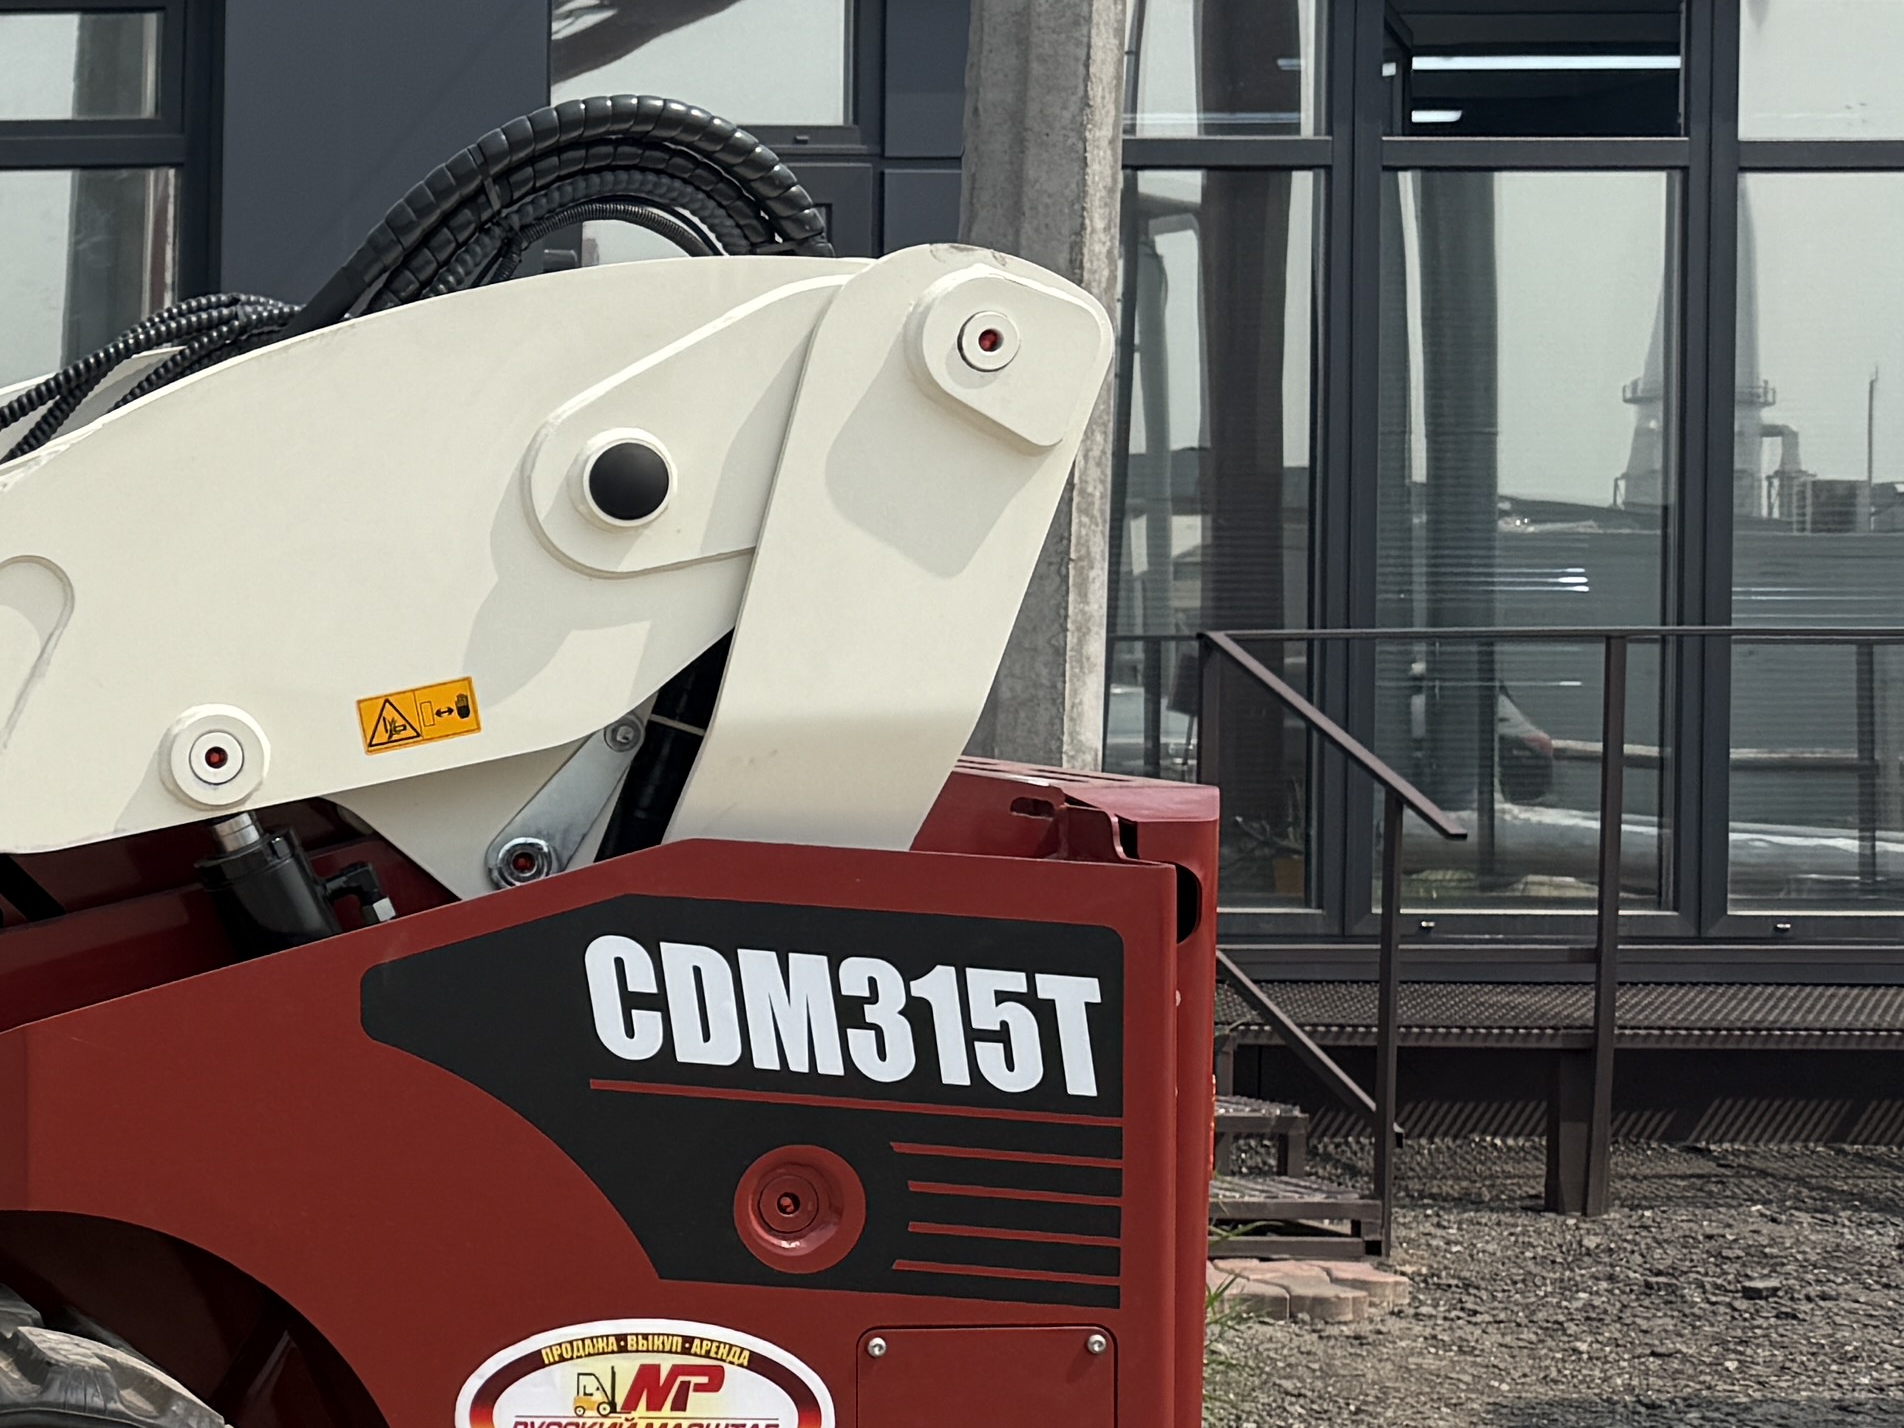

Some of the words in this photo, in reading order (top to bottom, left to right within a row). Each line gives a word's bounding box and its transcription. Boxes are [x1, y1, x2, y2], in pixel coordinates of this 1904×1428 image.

[584, 934, 1103, 1098] CDM315T
[542, 1336, 618, 1365] ПРОДАЖА
[627, 1334, 683, 1353] ВЫКУП
[691, 1337, 751, 1367] АРЕНДА
